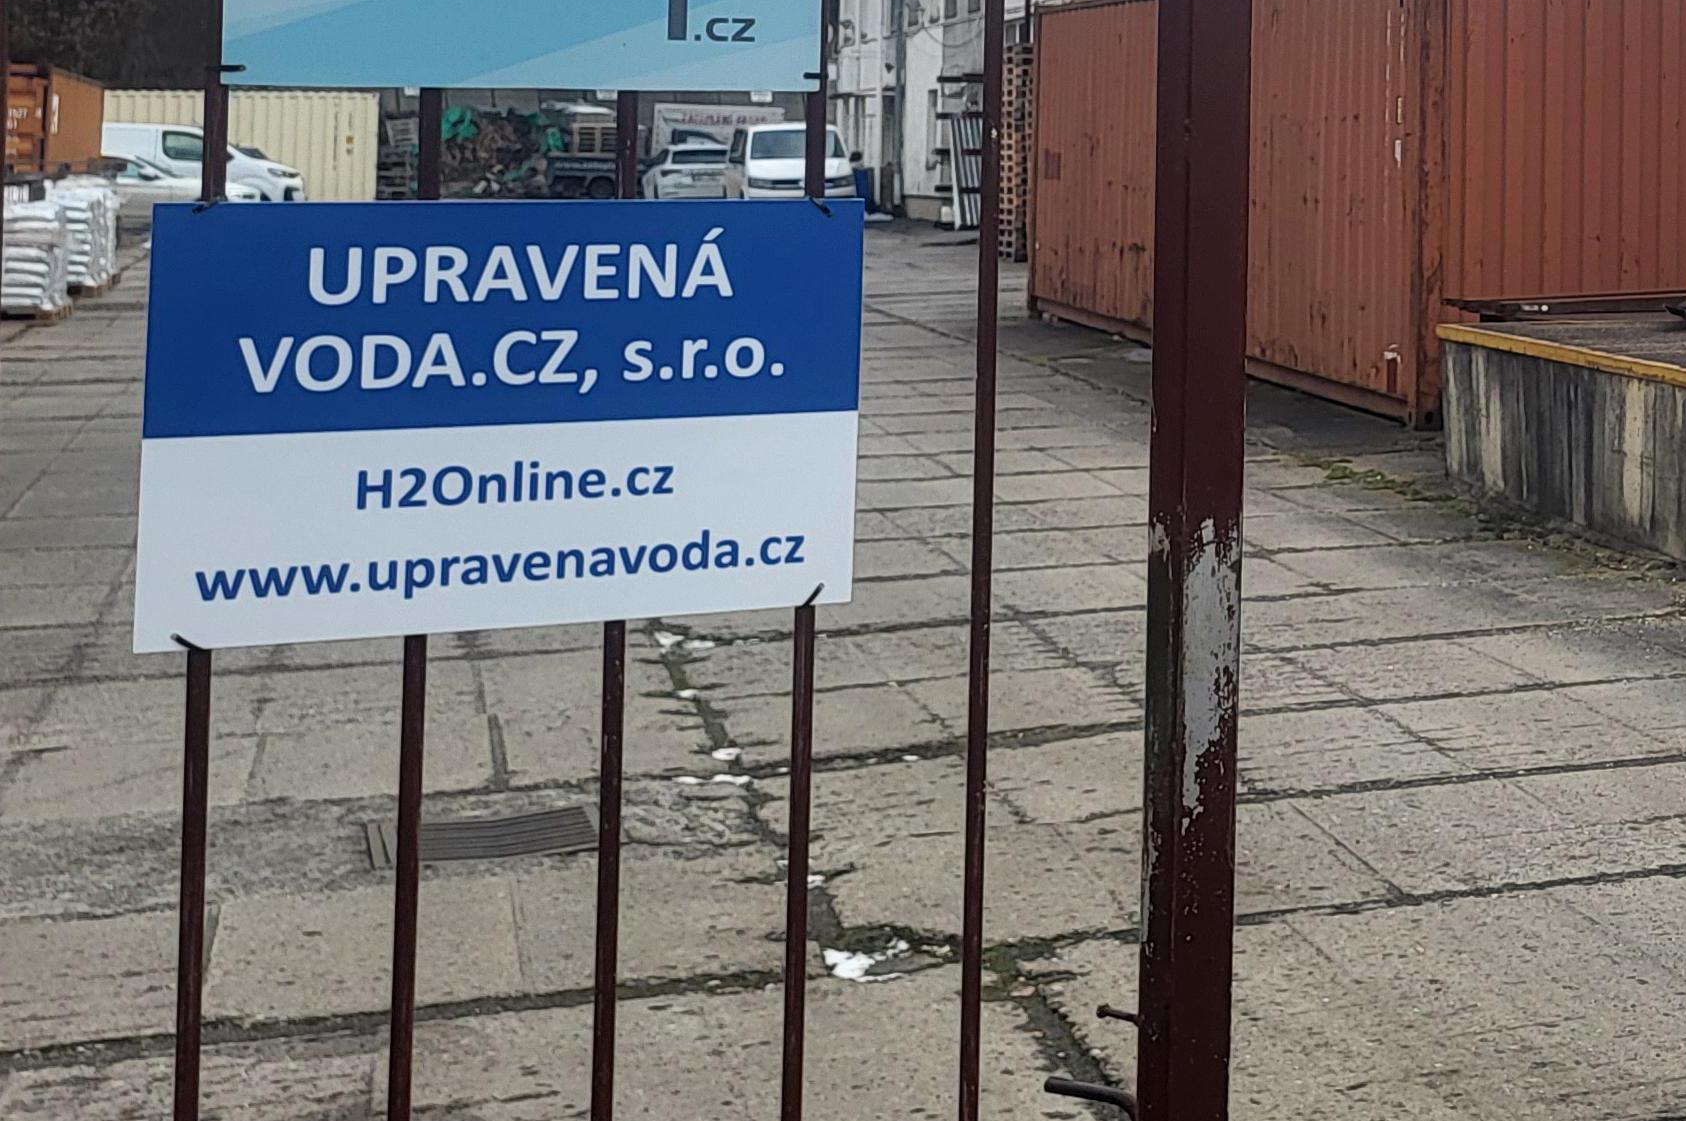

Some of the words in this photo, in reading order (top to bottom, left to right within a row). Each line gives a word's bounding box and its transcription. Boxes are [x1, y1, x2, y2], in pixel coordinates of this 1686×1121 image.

[308, 227, 734, 305] UPRAVENÁ
[239, 329, 599, 395] VODA.CZ,
[622, 336, 785, 382] s.r.o.
[355, 459, 675, 512] H2Online.cz
[195, 528, 806, 602] www.upravenavoda.cz
